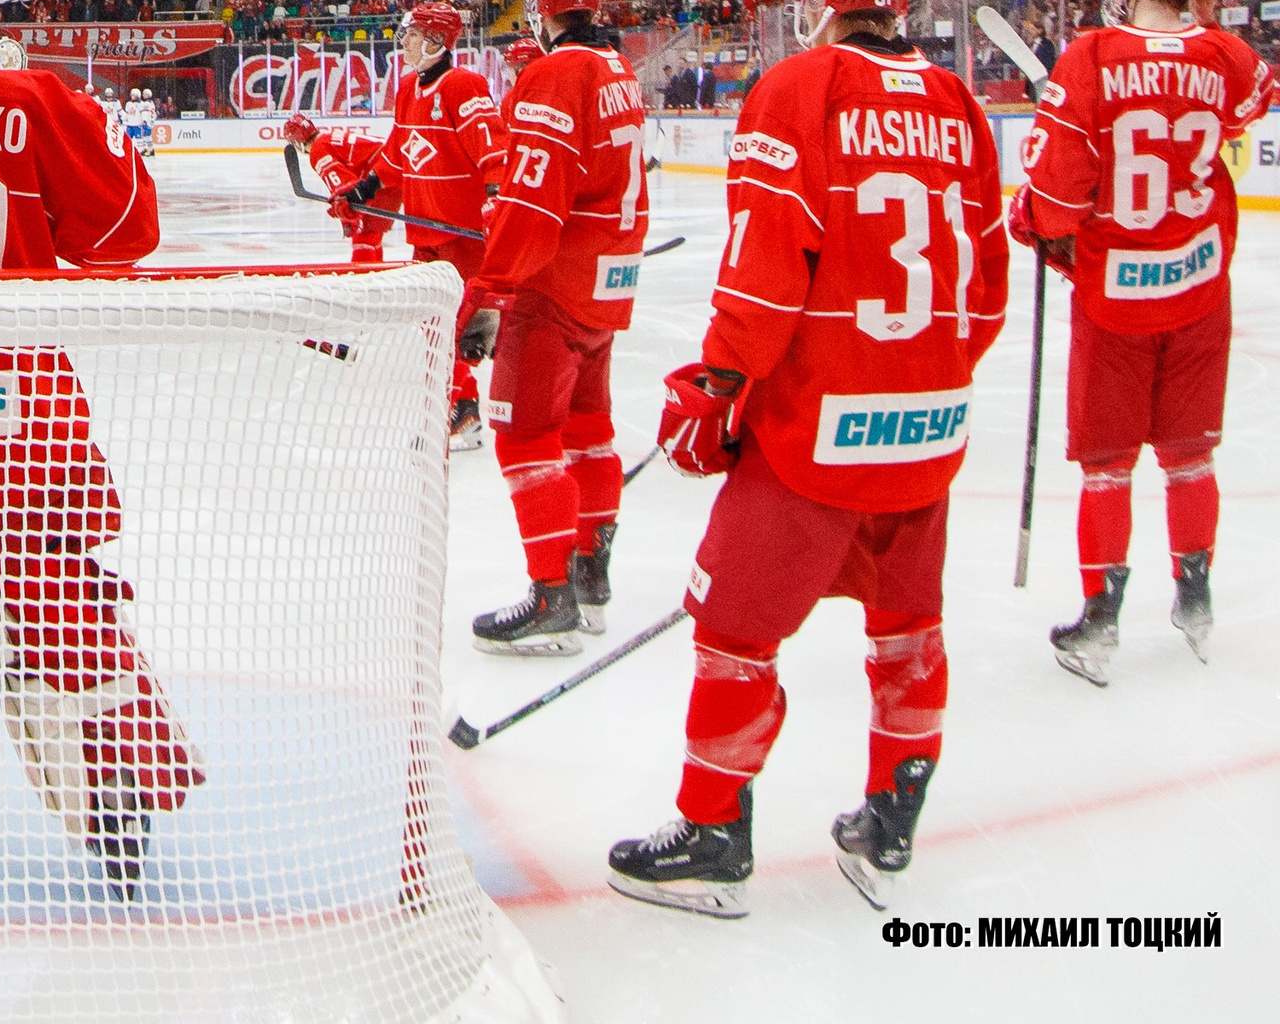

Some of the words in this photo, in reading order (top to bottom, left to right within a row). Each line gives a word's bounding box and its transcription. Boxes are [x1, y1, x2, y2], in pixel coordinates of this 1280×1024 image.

[177, 129, 202, 140] /mhl
[477, 122, 493, 147] 7
[519, 106, 571, 127] OLIMPBET
[840, 108, 973, 167] KASHAEV
[512, 145, 551, 189] 73
[1112, 108, 1222, 231] 63
[856, 172, 974, 341] 31
[1117, 241, 1215, 286] СИБУР
[834, 402, 968, 447] СИБУР
